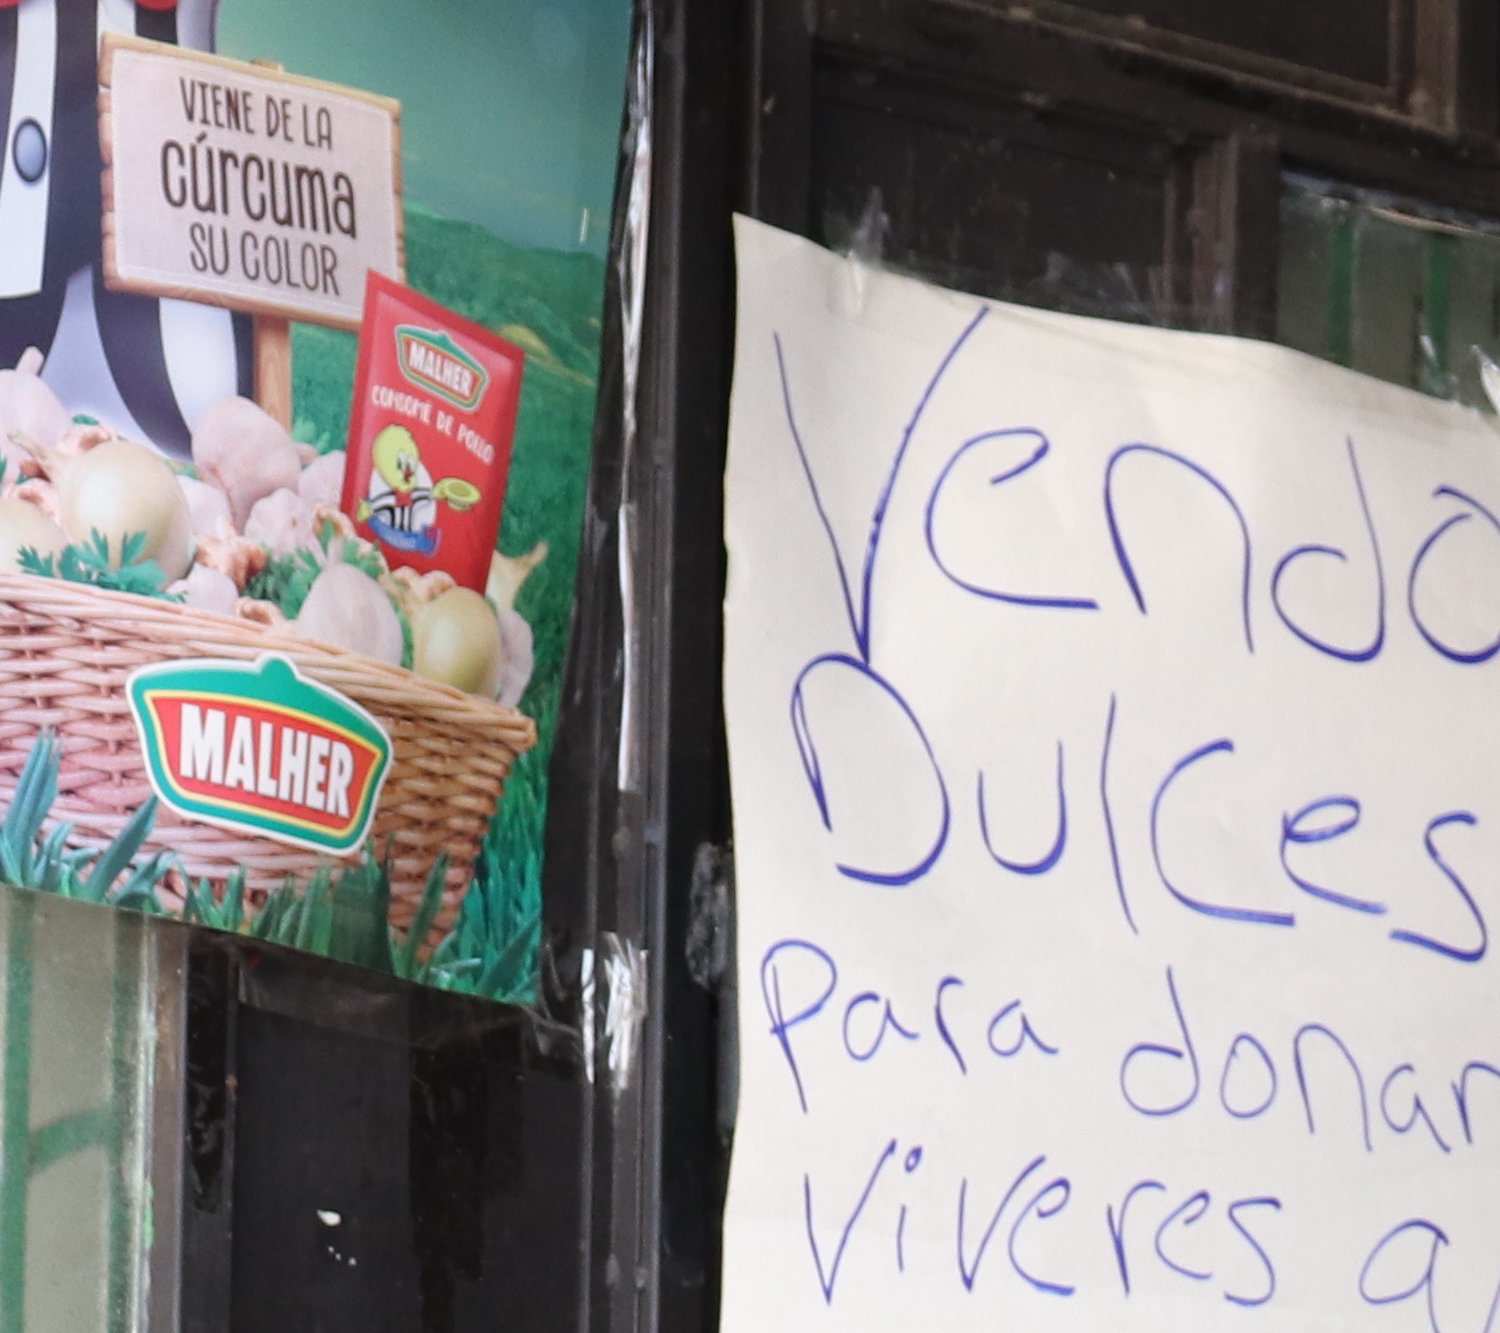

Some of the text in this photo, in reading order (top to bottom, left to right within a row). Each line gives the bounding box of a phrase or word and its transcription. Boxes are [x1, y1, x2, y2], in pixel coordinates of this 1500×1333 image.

[180, 77, 334, 145] VIENE DE LA
[188, 221, 339, 297] SU COLOR
[409, 341, 474, 397] MALHER
[436, 409, 454, 437] DE
[456, 423, 496, 465] POLLO
[177, 704, 358, 821] MALHER
[791, 651, 1488, 963] Dulces
